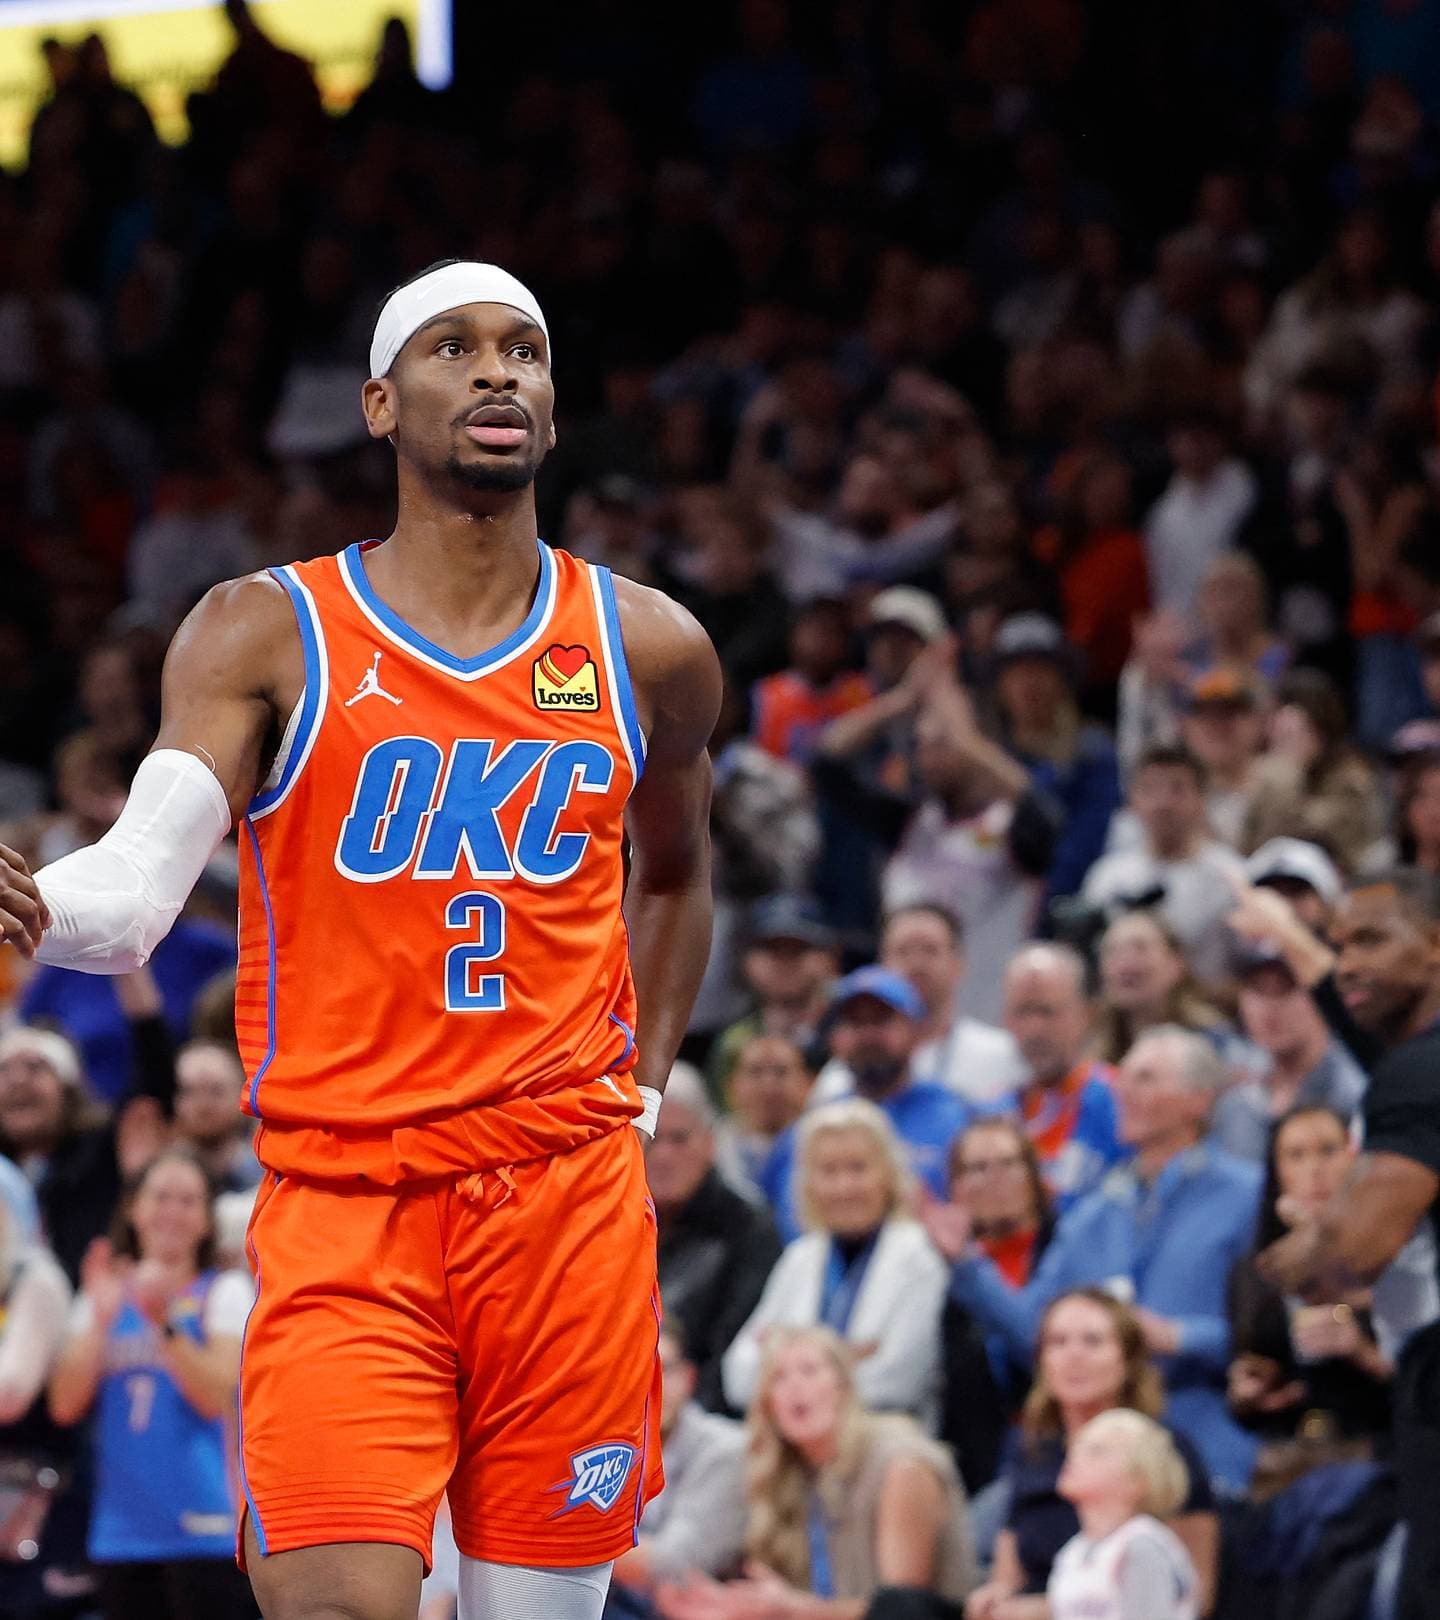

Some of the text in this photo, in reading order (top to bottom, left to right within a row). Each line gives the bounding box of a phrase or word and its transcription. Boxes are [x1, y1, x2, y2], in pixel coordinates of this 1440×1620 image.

[333, 735, 614, 885] OKC
[444, 890, 507, 1013] 2
[570, 1455, 623, 1500] OKC
